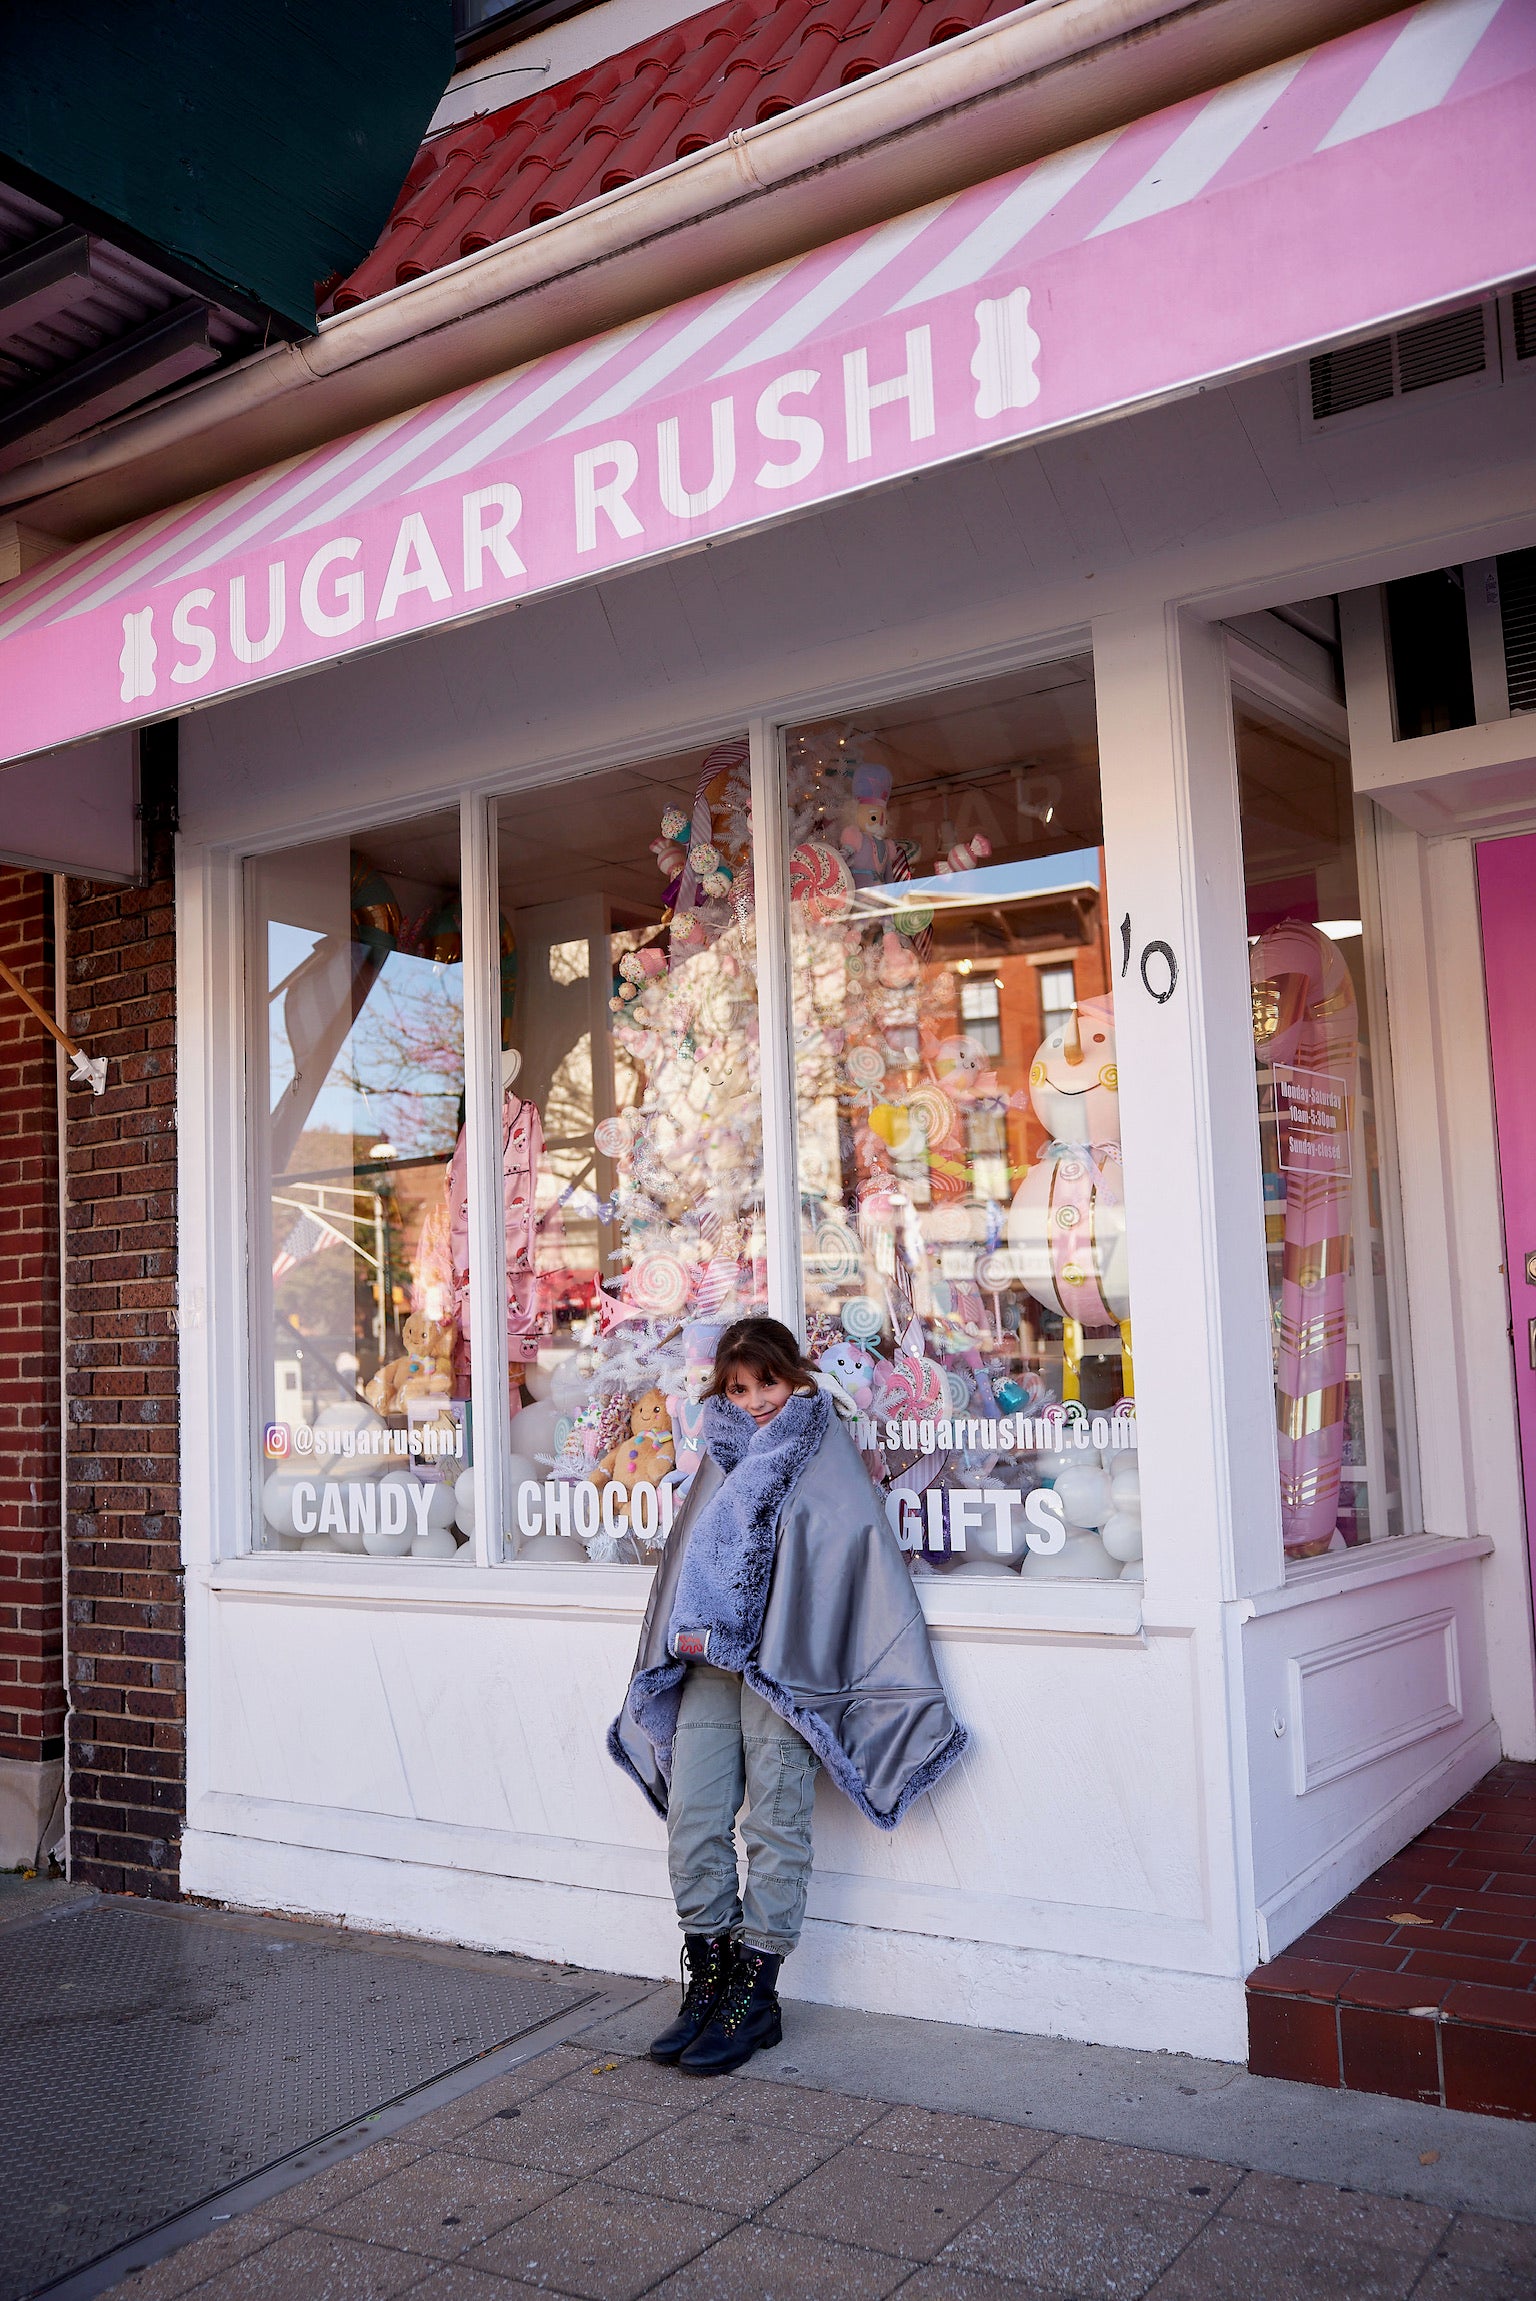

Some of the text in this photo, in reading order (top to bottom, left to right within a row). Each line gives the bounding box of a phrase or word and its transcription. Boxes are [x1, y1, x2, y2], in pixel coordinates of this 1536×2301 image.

[169, 323, 936, 685] SUGAR RUSH
[1120, 912, 1179, 1004] 10
[1280, 1081, 1341, 1109] Monday-Saturday
[1289, 1105, 1337, 1129] 10am-5:30pm
[1288, 1135, 1341, 1159] Sunday-closed
[293, 1423, 464, 1459] @sugarrushnj
[291, 1481, 437, 1536] CANDY
[884, 1487, 1067, 1556] GIFTS
